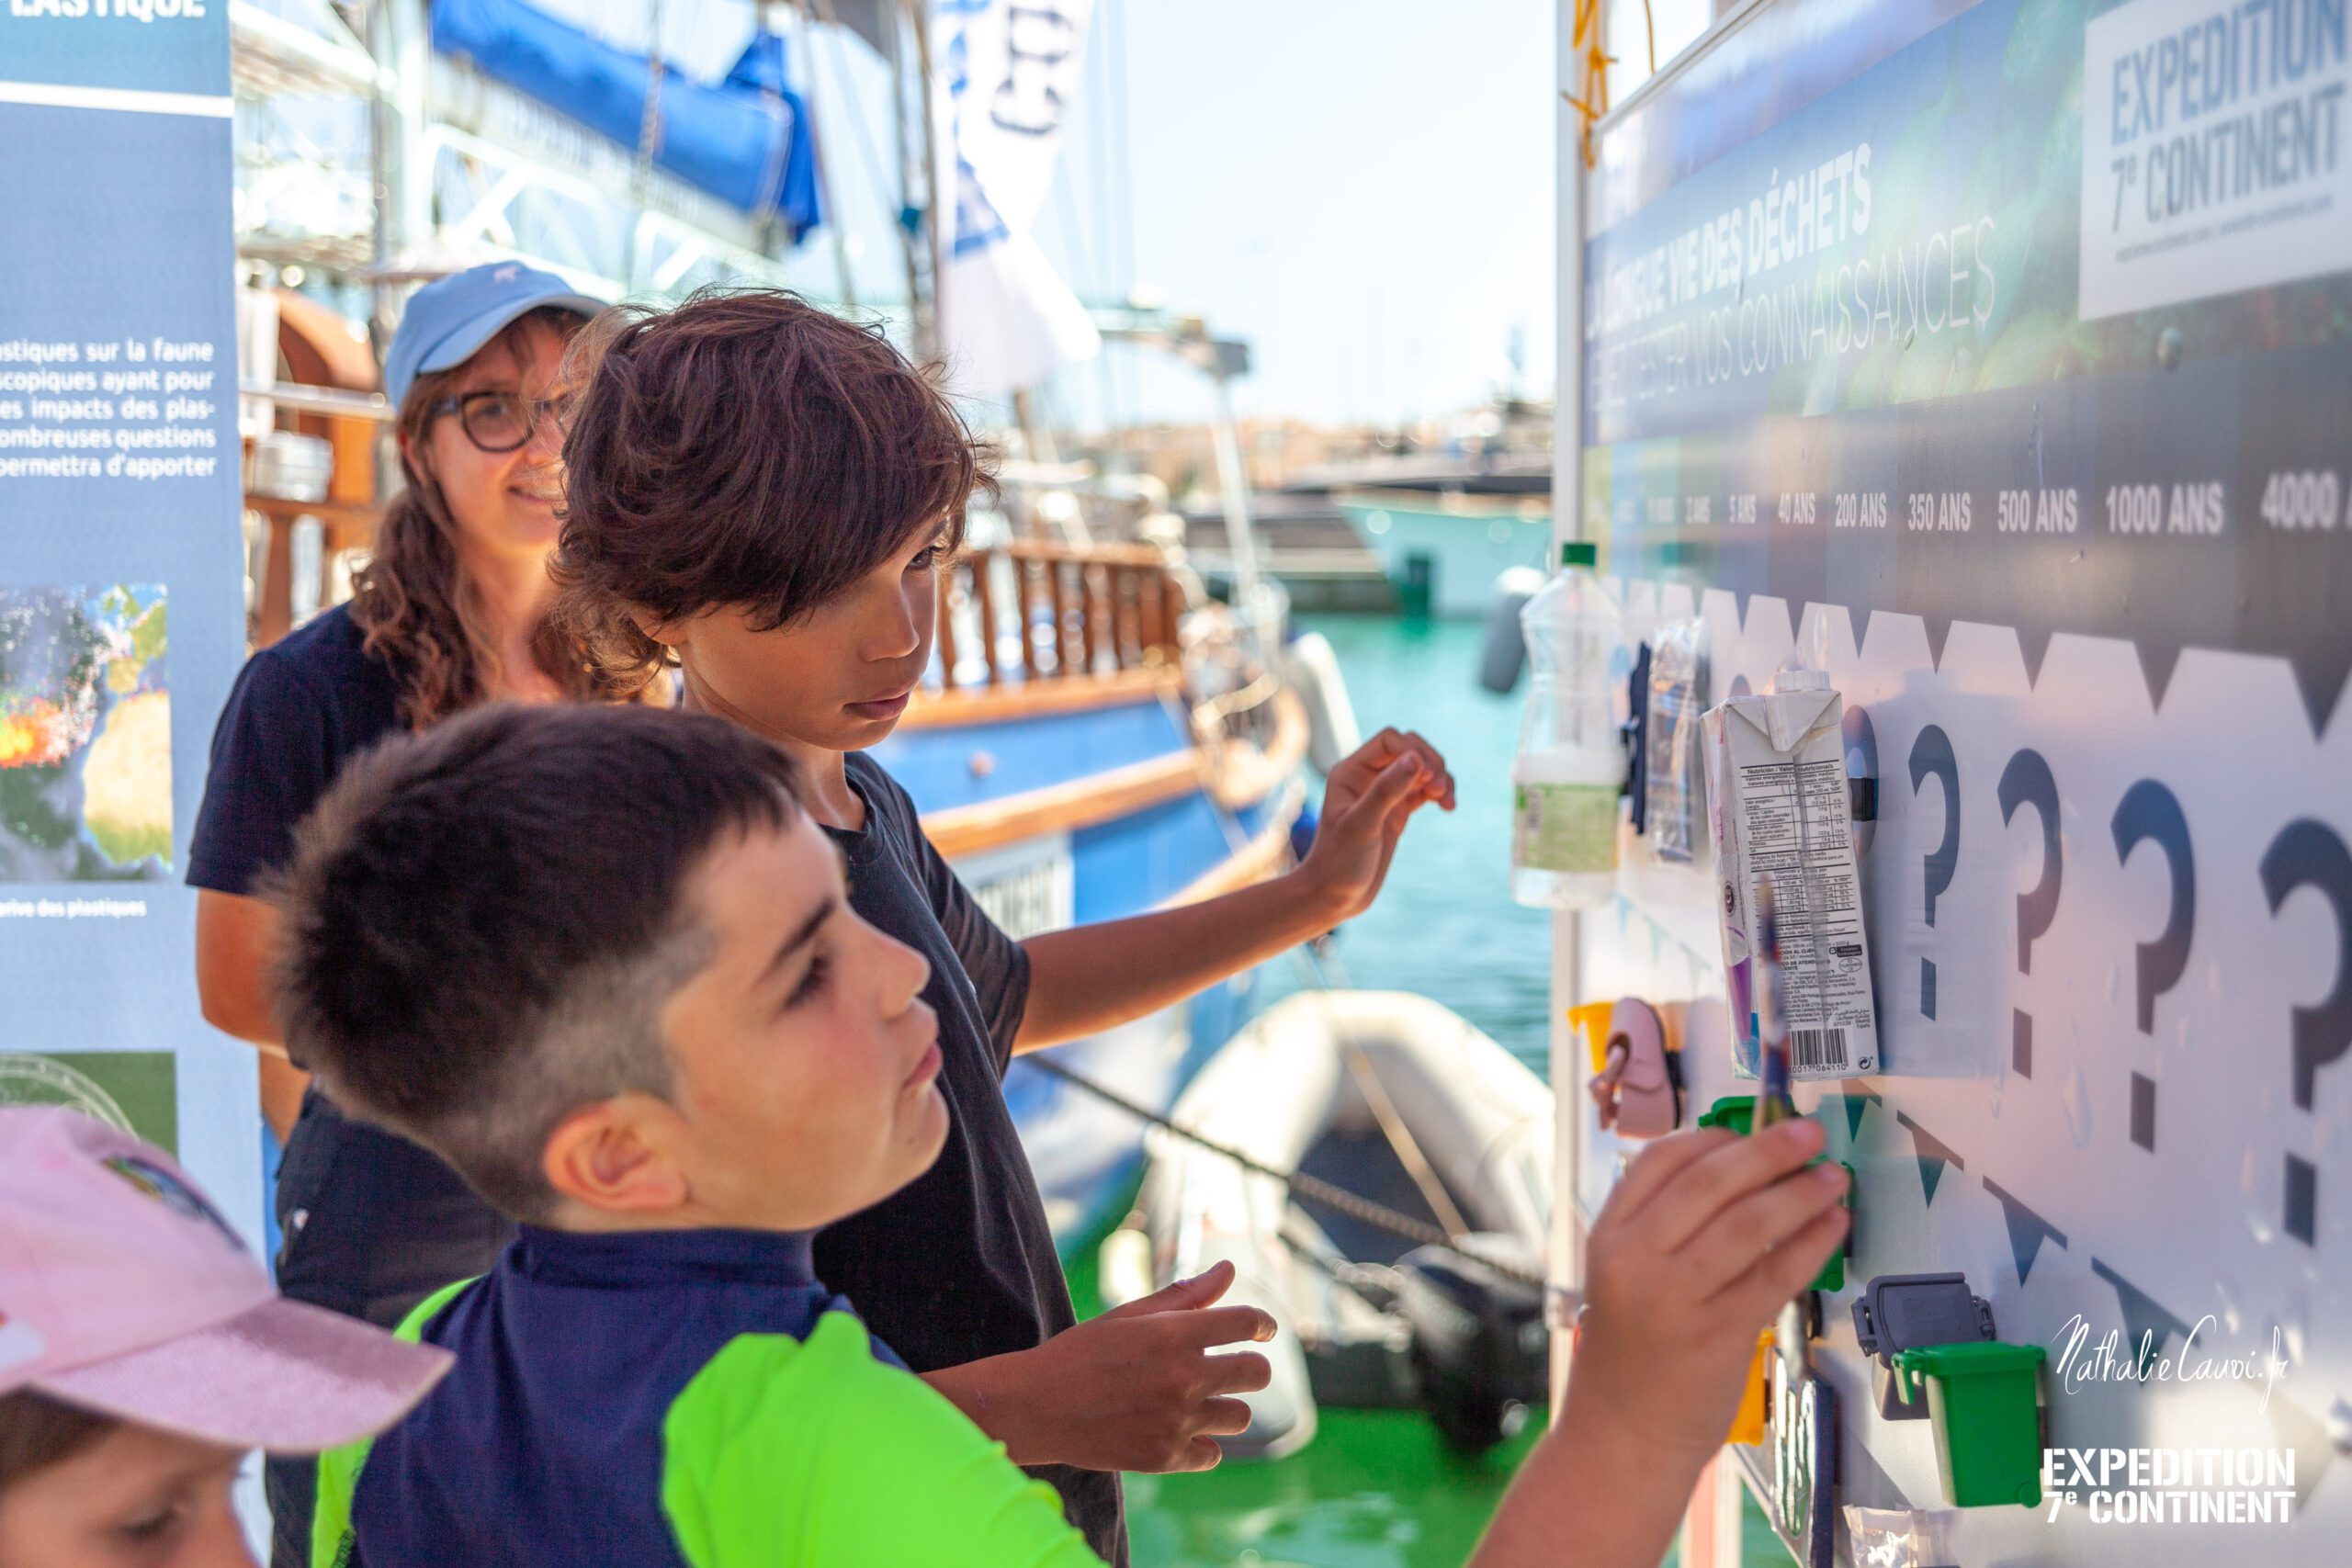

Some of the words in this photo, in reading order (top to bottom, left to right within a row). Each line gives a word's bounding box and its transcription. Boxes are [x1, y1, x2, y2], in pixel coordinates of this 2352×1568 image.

[2111, 0, 2347, 147] EXPEDITION
[2145, 81, 2346, 222] CONTINENT
[1668, 229, 1698, 307] VIE
[1703, 208, 1742, 294] DES
[1748, 142, 1871, 276] DÉCHETS
[1739, 216, 1996, 377] CONNAISSANCES
[0, 338, 79, 365] stiques
[85, 343, 119, 362] sur
[127, 337, 147, 362] la
[153, 336, 215, 362] faune
[0, 368, 97, 394] copiques
[103, 368, 160, 395] ayant
[164, 370, 216, 394] pour
[31, 396, 114, 423] impacts
[121, 395, 159, 420] des
[165, 395, 217, 423] plas-
[115, 424, 217, 452] questions
[107, 453, 218, 480] d'apporter
[1737, 494, 1756, 525] ANS
[1779, 493, 1791, 525] 40
[1793, 492, 1815, 525] ANS
[1835, 493, 1857, 527] 200
[1860, 492, 1887, 528] ANS
[1908, 493, 1934, 531] 350
[1938, 492, 1971, 532] ANS
[1997, 491, 2030, 532] 500
[2035, 488, 2077, 533] ANS
[2105, 484, 2162, 534] 1000
[2167, 481, 2224, 536] ANS
[2259, 470, 2340, 530] 4000
[0, 898, 34, 918] rive
[67, 897, 147, 919] plastiques
